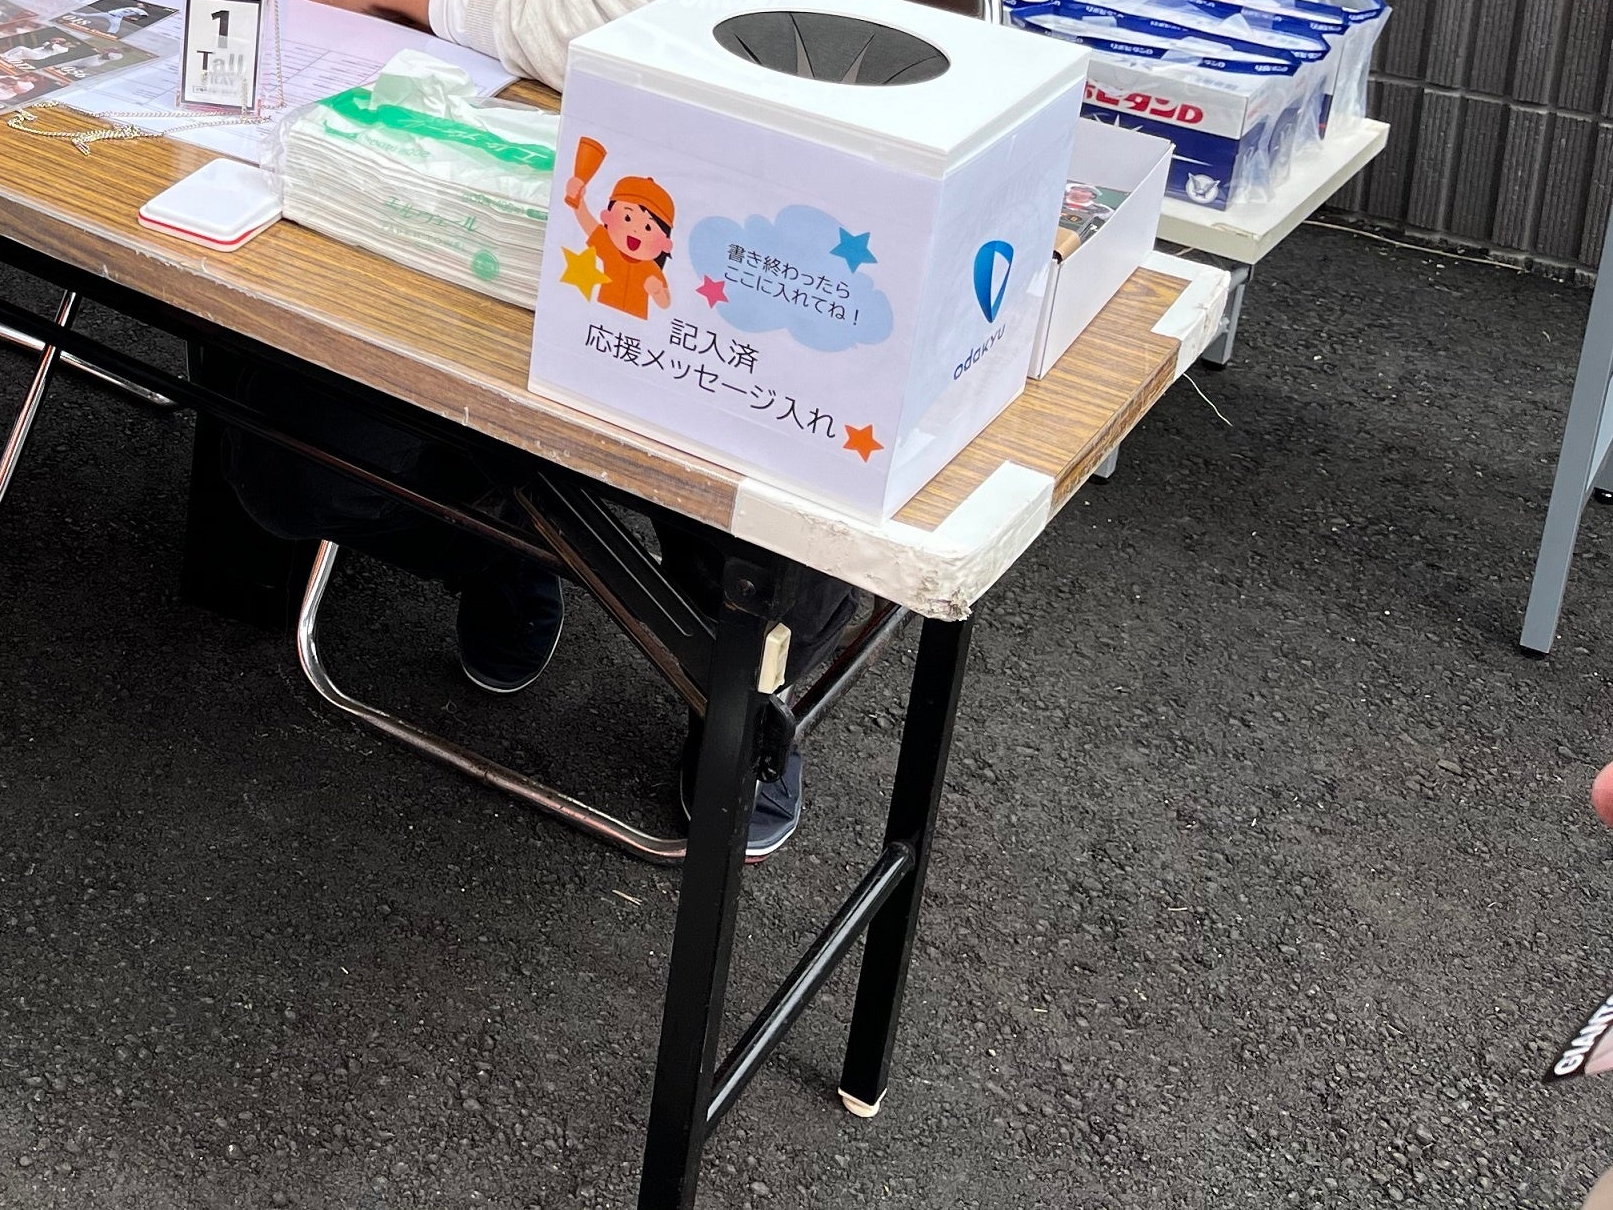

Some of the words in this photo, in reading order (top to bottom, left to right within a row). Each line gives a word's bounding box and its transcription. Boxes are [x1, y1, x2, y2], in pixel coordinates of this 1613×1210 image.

[211, 10, 230, 48] 1
[723, 265, 861, 326] ここに入れてね！
[726, 242, 851, 299] 書き終わったら
[670, 318, 760, 375] 記入済
[953, 323, 1006, 381] odakyu
[585, 323, 838, 439] 応援メッセージ入れ
